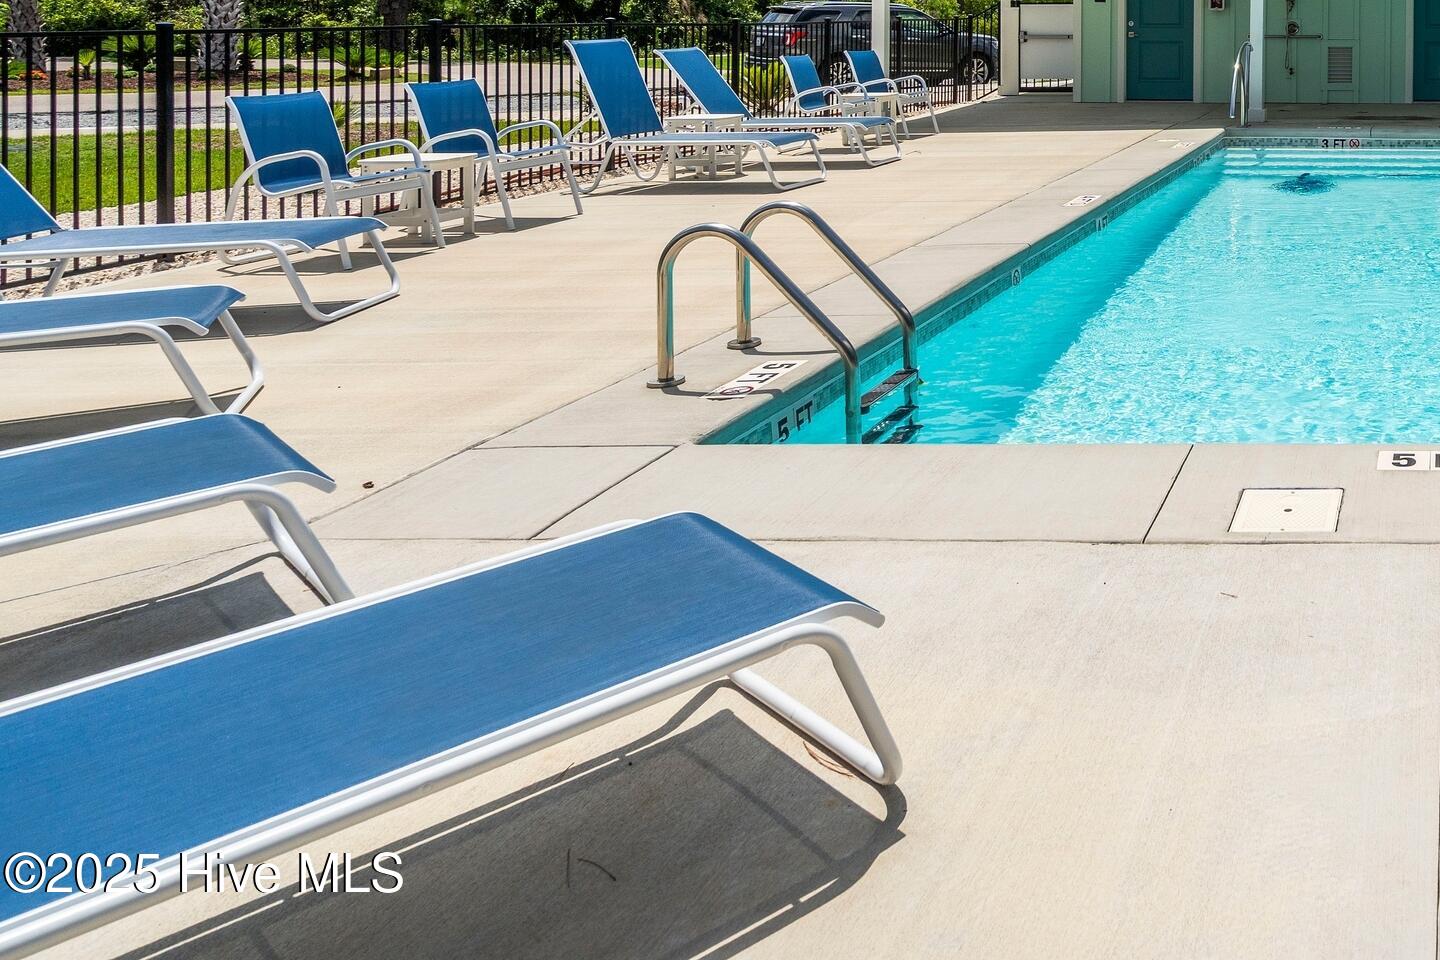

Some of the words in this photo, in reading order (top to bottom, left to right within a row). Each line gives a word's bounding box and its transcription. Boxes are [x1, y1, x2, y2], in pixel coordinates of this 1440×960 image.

[1322, 139, 1328, 148] 3
[1334, 139, 1346, 149] FT
[736, 372, 780, 384] FT
[777, 416, 790, 442] 5
[796, 400, 813, 431] FT
[1392, 453, 1416, 467] 5
